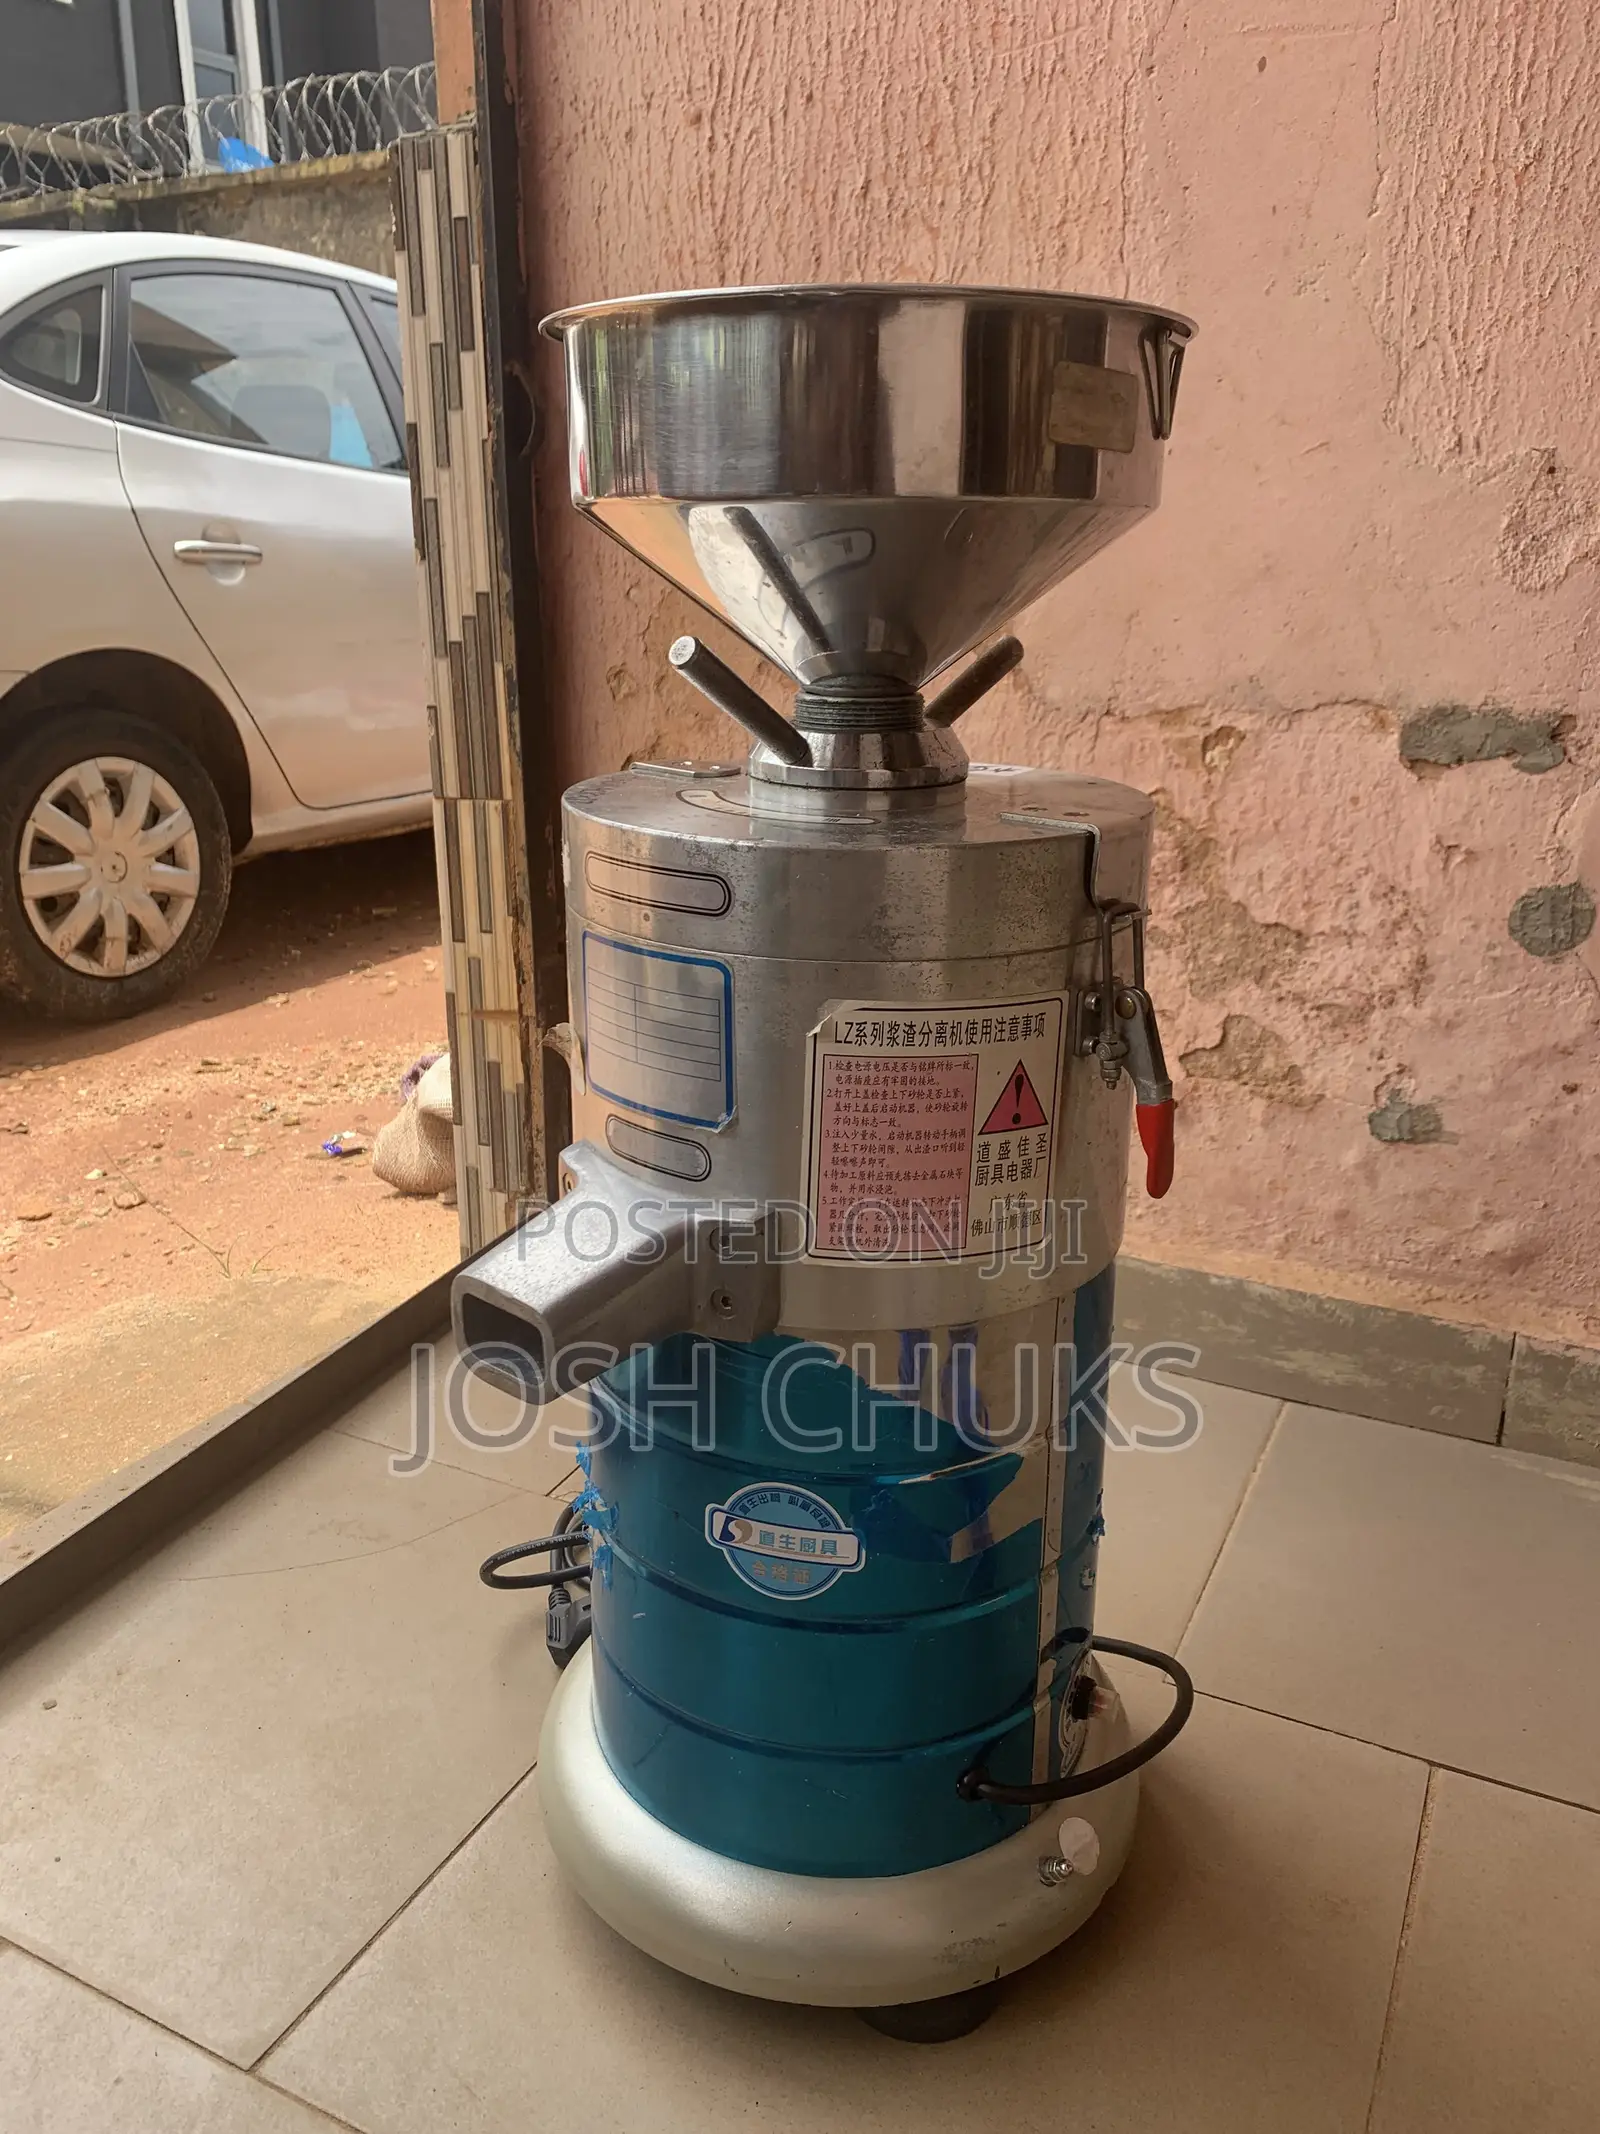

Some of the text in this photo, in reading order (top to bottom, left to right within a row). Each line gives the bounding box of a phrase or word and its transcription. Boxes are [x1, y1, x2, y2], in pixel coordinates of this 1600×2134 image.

[834, 1011, 1046, 1047] LZ系列浆渣分离机使用注意事项
[974, 1156, 1047, 1187] 厨具电器厂
